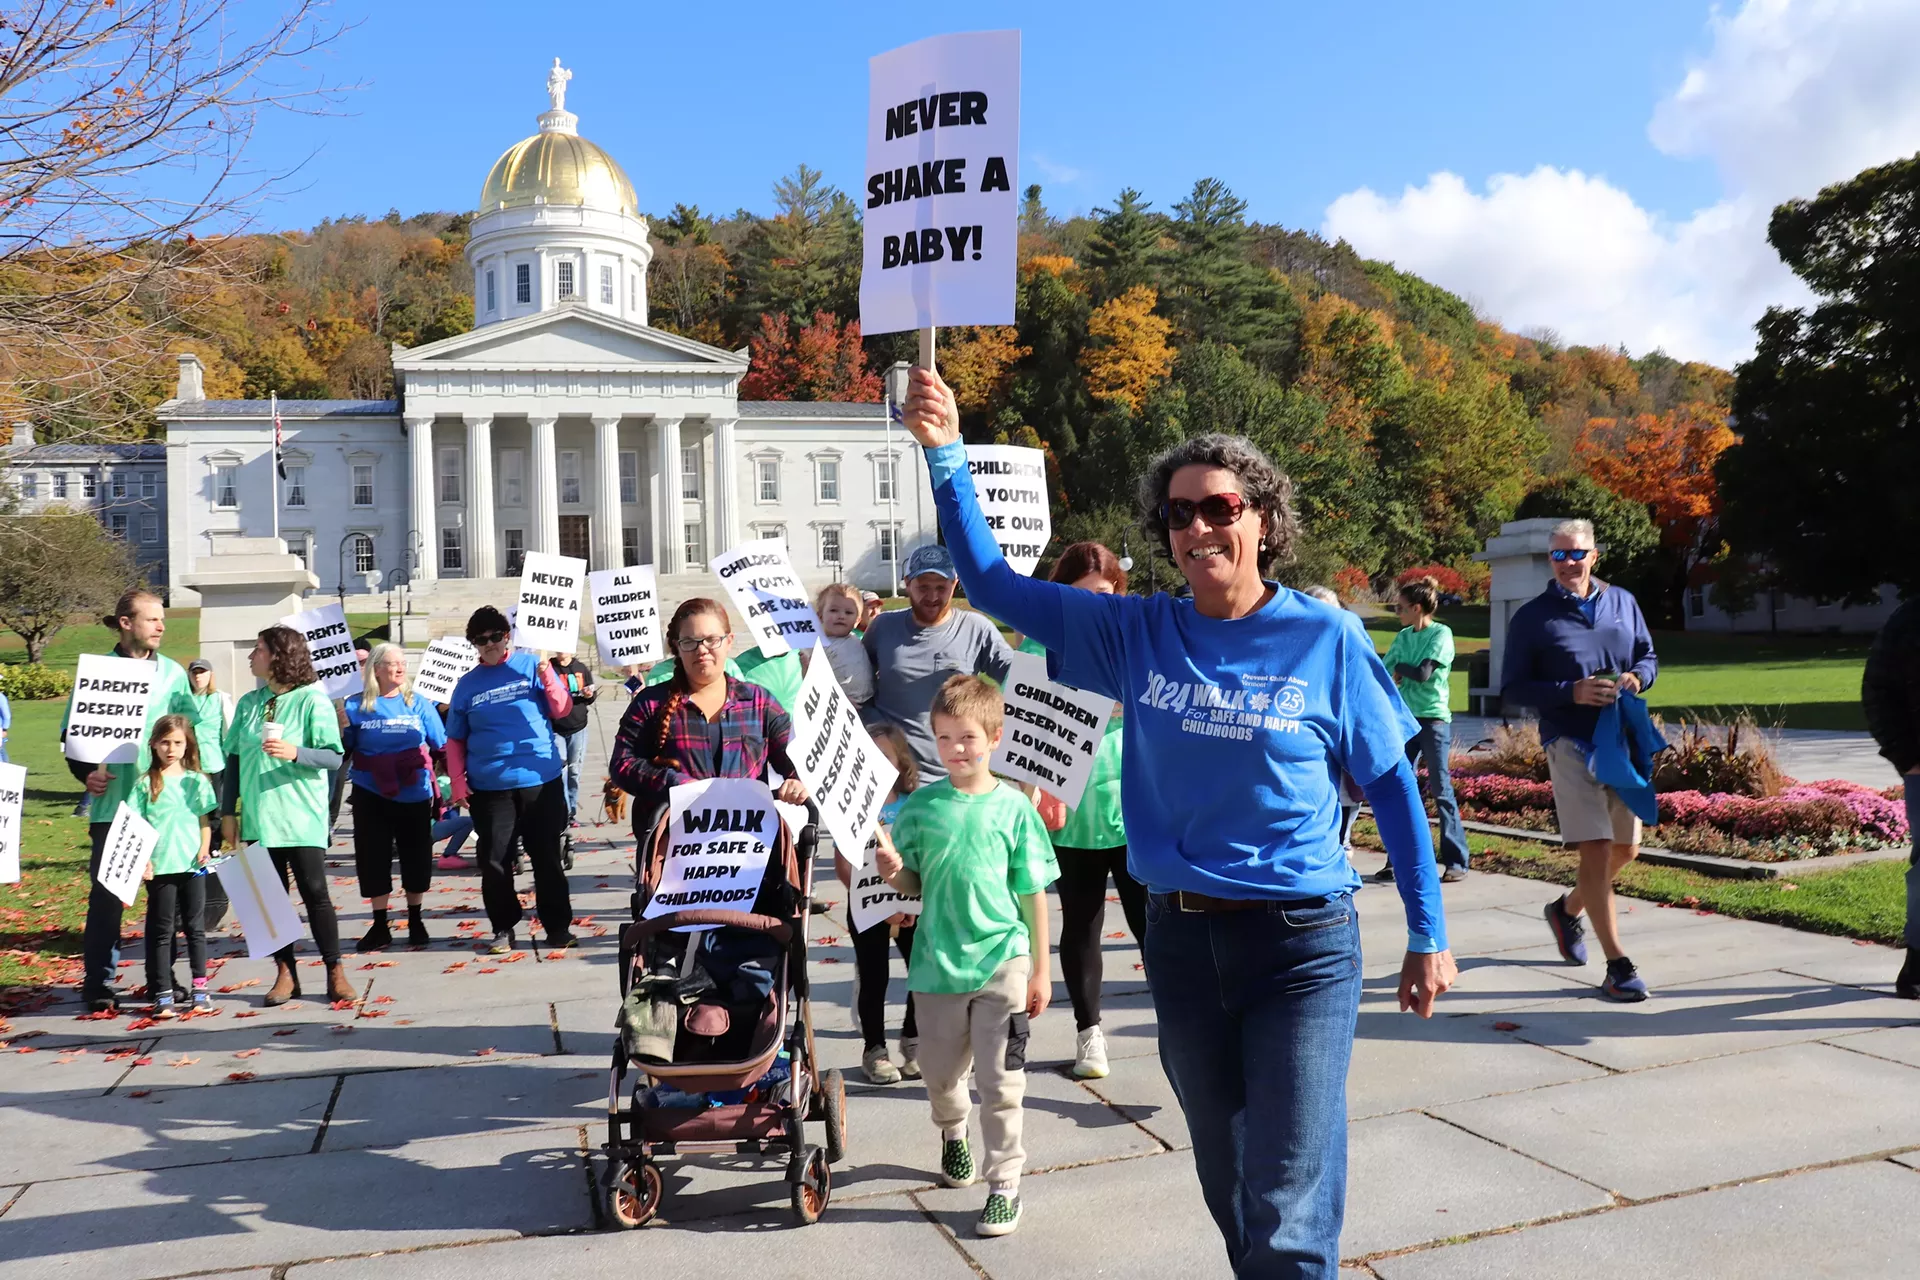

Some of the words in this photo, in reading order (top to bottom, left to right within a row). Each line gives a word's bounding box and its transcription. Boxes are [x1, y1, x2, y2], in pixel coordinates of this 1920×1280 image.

[885, 91, 988, 141] NEVER
[867, 158, 966, 209] SHAKE
[980, 156, 1010, 192] A
[882, 225, 983, 270] BABY!
[986, 488, 1040, 504] YOUTH
[985, 516, 1005, 529] RE
[1011, 516, 1044, 531] OUR
[999, 543, 1041, 558] TURE
[531, 571, 574, 588] NEVER
[613, 575, 632, 586] ALL
[747, 576, 795, 591] YOUTH
[521, 592, 565, 608] SHAKE
[569, 600, 578, 611] A
[598, 590, 651, 606] CHILDREN
[596, 609, 645, 624] DESERVE
[649, 607, 656, 616] A
[748, 599, 778, 618] ARE
[780, 598, 808, 610] OUR
[306, 622, 346, 641] RENTS
[527, 615, 568, 631] BABY!
[763, 620, 816, 639] FUTURE
[609, 626, 649, 640] LOVING
[311, 642, 351, 661] SERVE
[428, 645, 463, 660] CHILDREN
[611, 643, 650, 658] FAMILY
[316, 661, 357, 681] PPORT
[432, 659, 457, 671] YOUTH
[79, 678, 149, 694] PARENTS
[418, 681, 448, 694] FUTURE
[1241, 680, 1266, 688] Vermont
[1242, 673, 1269, 681] Prevent
[1287, 676, 1309, 687] Abuse
[1139, 669, 1191, 714] 2024
[1191, 683, 1249, 711] WALK
[76, 702, 144, 717] DESERVE
[803, 685, 821, 721] ALL
[1014, 683, 1099, 729] CHILDREN
[360, 719, 381, 729] 2024
[805, 686, 840, 773] CHILDREN
[1004, 702, 1078, 745] DESERVE
[1080, 740, 1093, 755] A
[1182, 718, 1253, 742] CHILDHOODS
[1185, 708, 1209, 720] For
[1209, 709, 1235, 724] SAFE
[1236, 713, 1262, 728] AND
[1264, 716, 1300, 735] HAPPY
[69, 724, 142, 739] SUPPORT
[815, 723, 852, 806] DESERVE
[846, 707, 856, 726] A
[1011, 729, 1073, 767] LOVING
[1005, 750, 1067, 788] FAMILY
[837, 747, 866, 815] LOVING
[850, 770, 879, 839] FAMILY
[682, 808, 766, 834] WALK
[671, 843, 702, 858] FOR
[706, 841, 748, 855] SAFE
[752, 841, 765, 854] &
[683, 865, 741, 881] HAPPY
[856, 875, 887, 889] AR
[655, 887, 757, 906] CHILDHOODS
[861, 892, 922, 910] FUTUR
